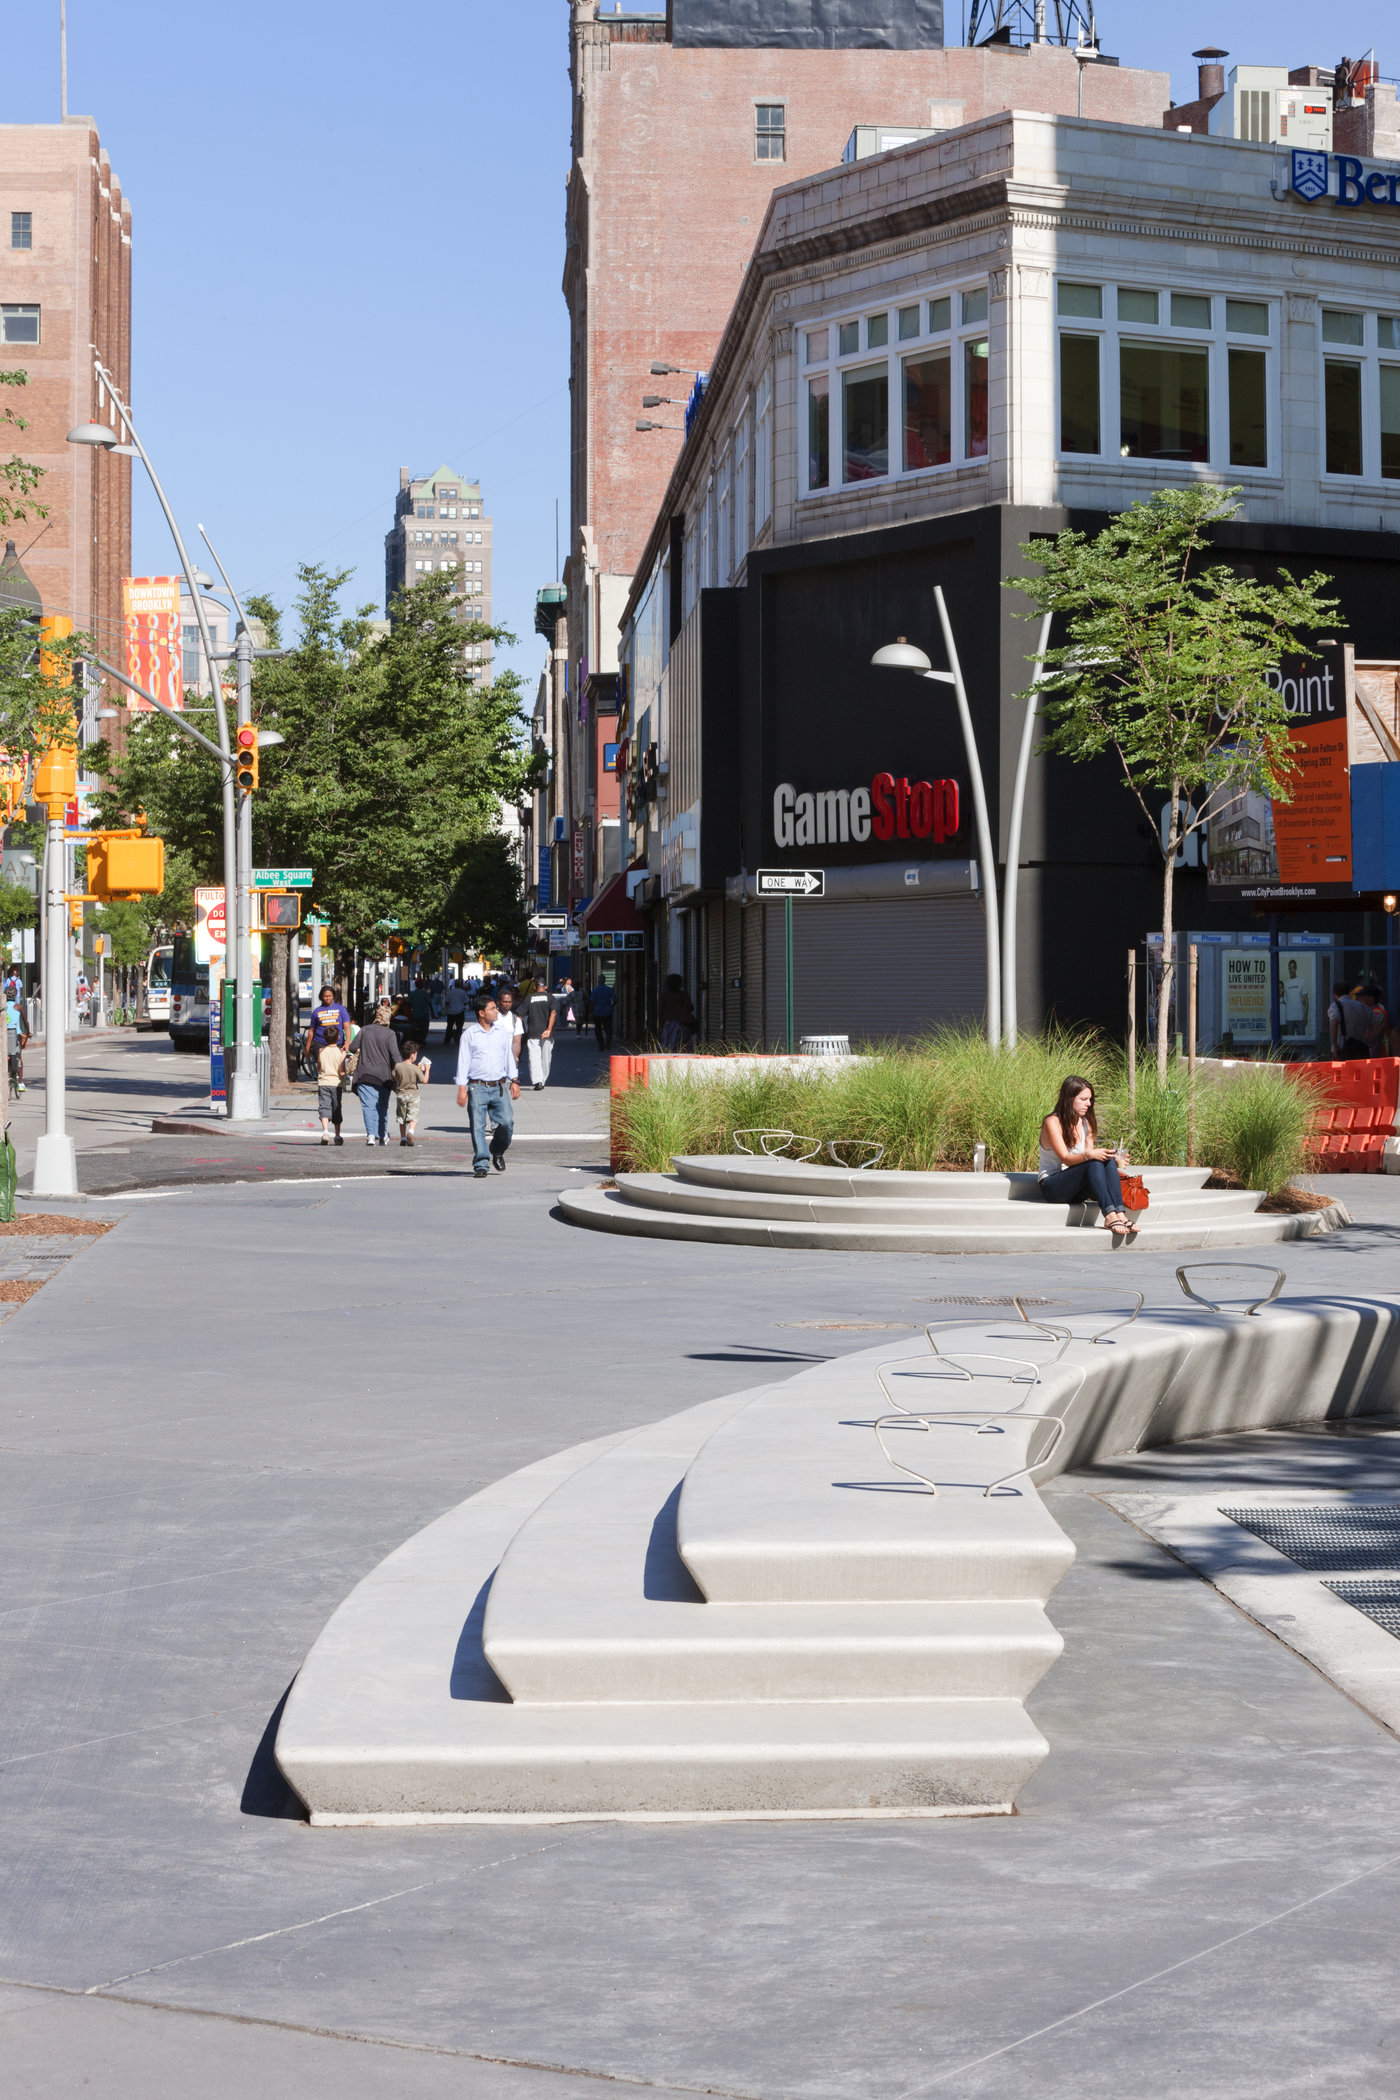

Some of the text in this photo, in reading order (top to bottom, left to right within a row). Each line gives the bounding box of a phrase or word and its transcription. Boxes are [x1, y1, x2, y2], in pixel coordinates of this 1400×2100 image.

[129, 587, 175, 599] DOWNTOWN
[132, 599, 172, 611] BROOKLYN
[1320, 744, 1337, 753] Fulton
[1300, 758, 1318, 768] Spring
[773, 772, 960, 848] GameStop
[256, 870, 312, 881] Albee Square
[272, 879, 291, 887] West
[767, 878, 814, 887] ONE WAY
[1241, 887, 1316, 898] www.CityPointBrooklyn.com
[213, 910, 224, 918] DO
[1201, 934, 1222, 942] Phone
[1301, 935, 1321, 943] Phone
[1229, 960, 1266, 973] HOW TO
[1229, 974, 1268, 984] LIVE UNITED:
